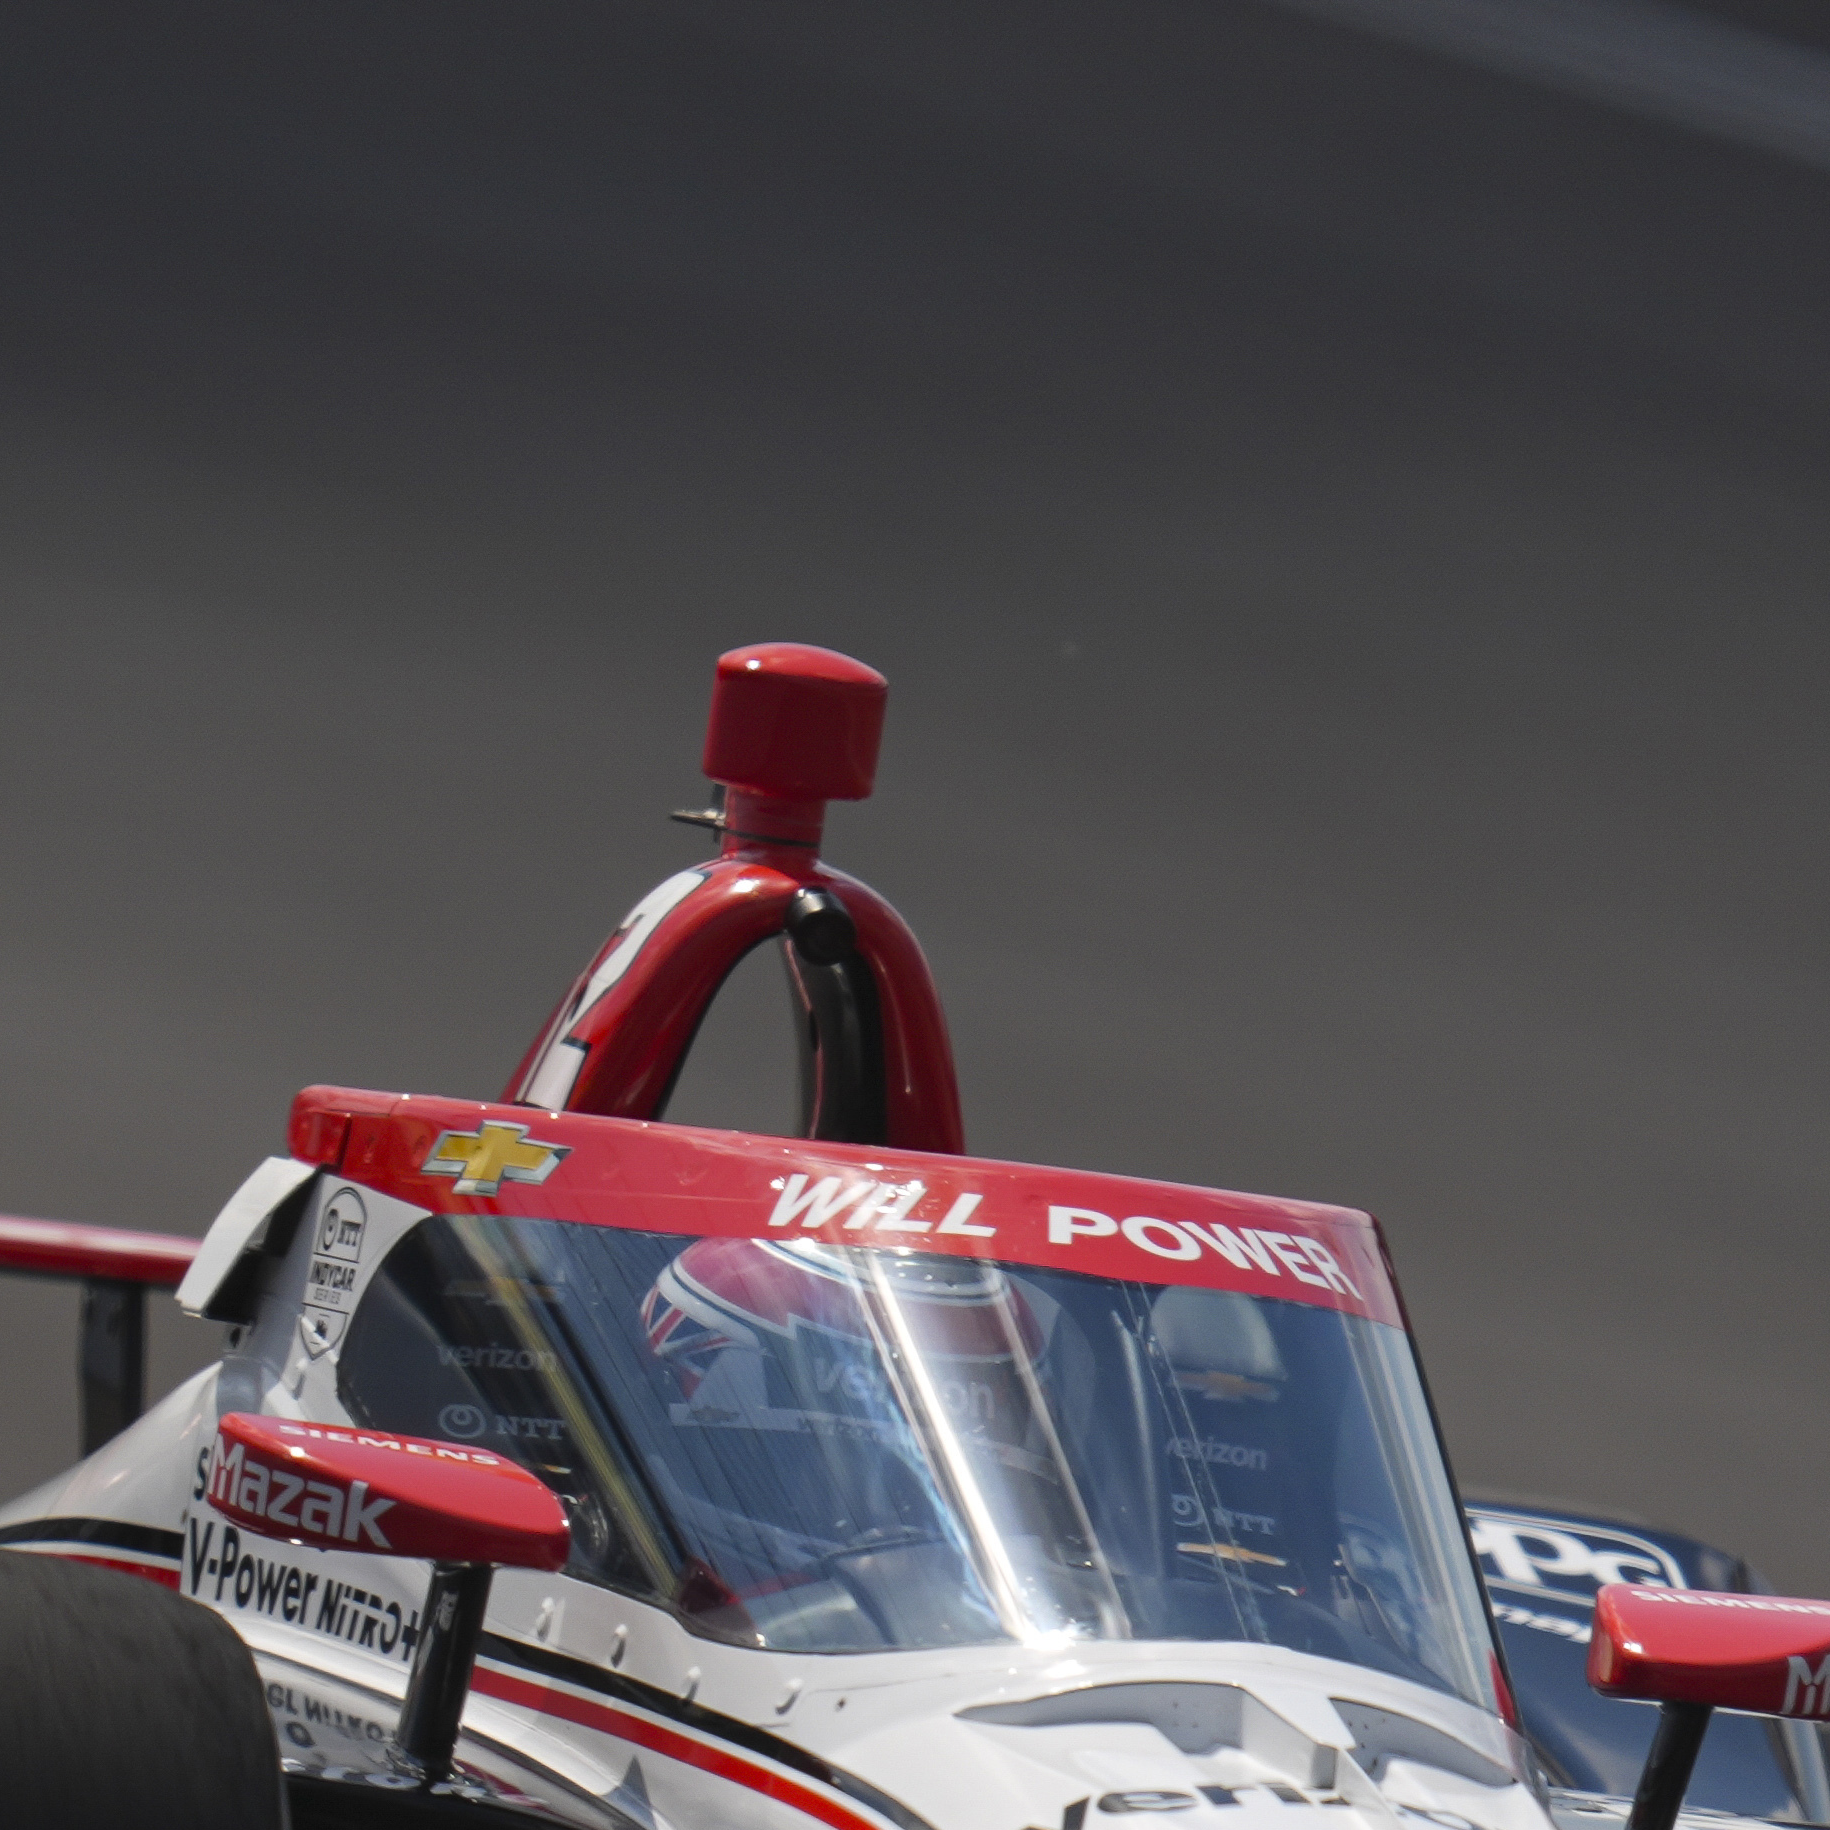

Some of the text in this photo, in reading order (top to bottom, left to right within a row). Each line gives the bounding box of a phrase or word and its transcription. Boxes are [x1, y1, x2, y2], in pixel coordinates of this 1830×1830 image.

[767, 1172, 1366, 1301] WILL POWER
[309, 1261, 358, 1291] INDYCAR
[436, 1341, 558, 1373] verizon
[279, 1424, 500, 1466] SIEMENS
[495, 1414, 567, 1441] NTT
[206, 1432, 398, 1550] Mazak
[189, 1517, 320, 1627] V-Power
